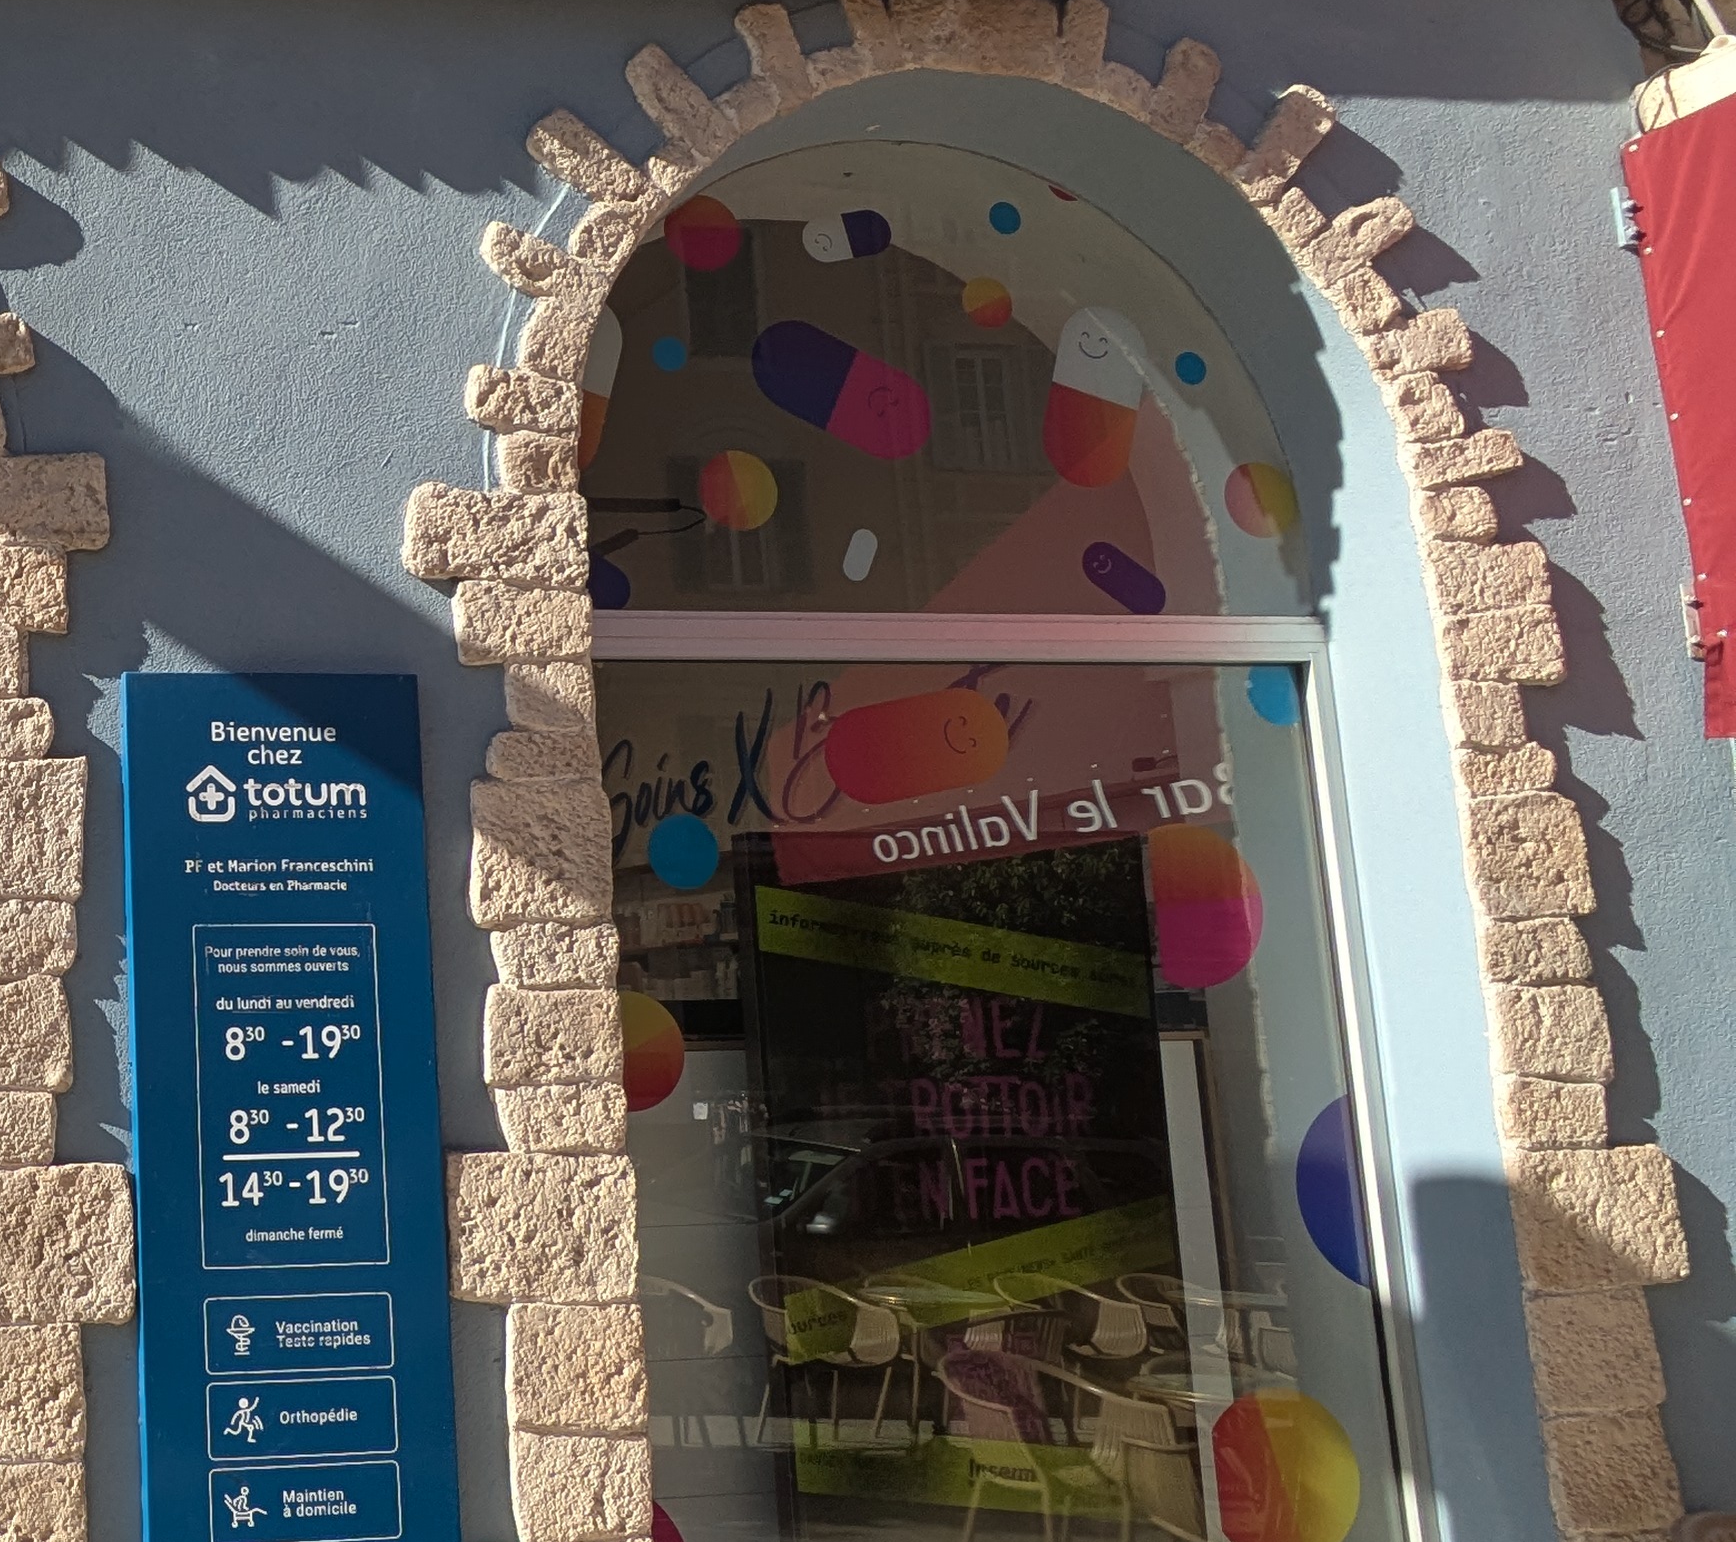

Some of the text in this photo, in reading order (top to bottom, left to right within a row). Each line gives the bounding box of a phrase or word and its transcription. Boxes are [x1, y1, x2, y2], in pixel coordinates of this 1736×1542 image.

[210, 721, 337, 742] Bienvenue
[247, 745, 303, 765] chez
[243, 778, 366, 807] totum
[249, 807, 368, 822] pharmaciens
[207, 861, 224, 873] et
[228, 859, 277, 874] Marion
[281, 859, 374, 873] Franceschini
[213, 879, 348, 892] Docteurs en Pharmacie
[205, 945, 361, 960] Pour prendre soin de vous,
[218, 960, 350, 974] nous sommes ouverts
[216, 996, 356, 1011] du lundi au vendredi
[257, 1079, 321, 1095] le samedi
[245, 1226, 344, 1242] dimanche fermé
[275, 1319, 359, 1335] Vaccination
[276, 1333, 371, 1349] Tests rapides
[279, 1408, 358, 1426] Orthopédie
[282, 1489, 345, 1503] Maintien
[283, 1501, 357, 1518] à domicile
